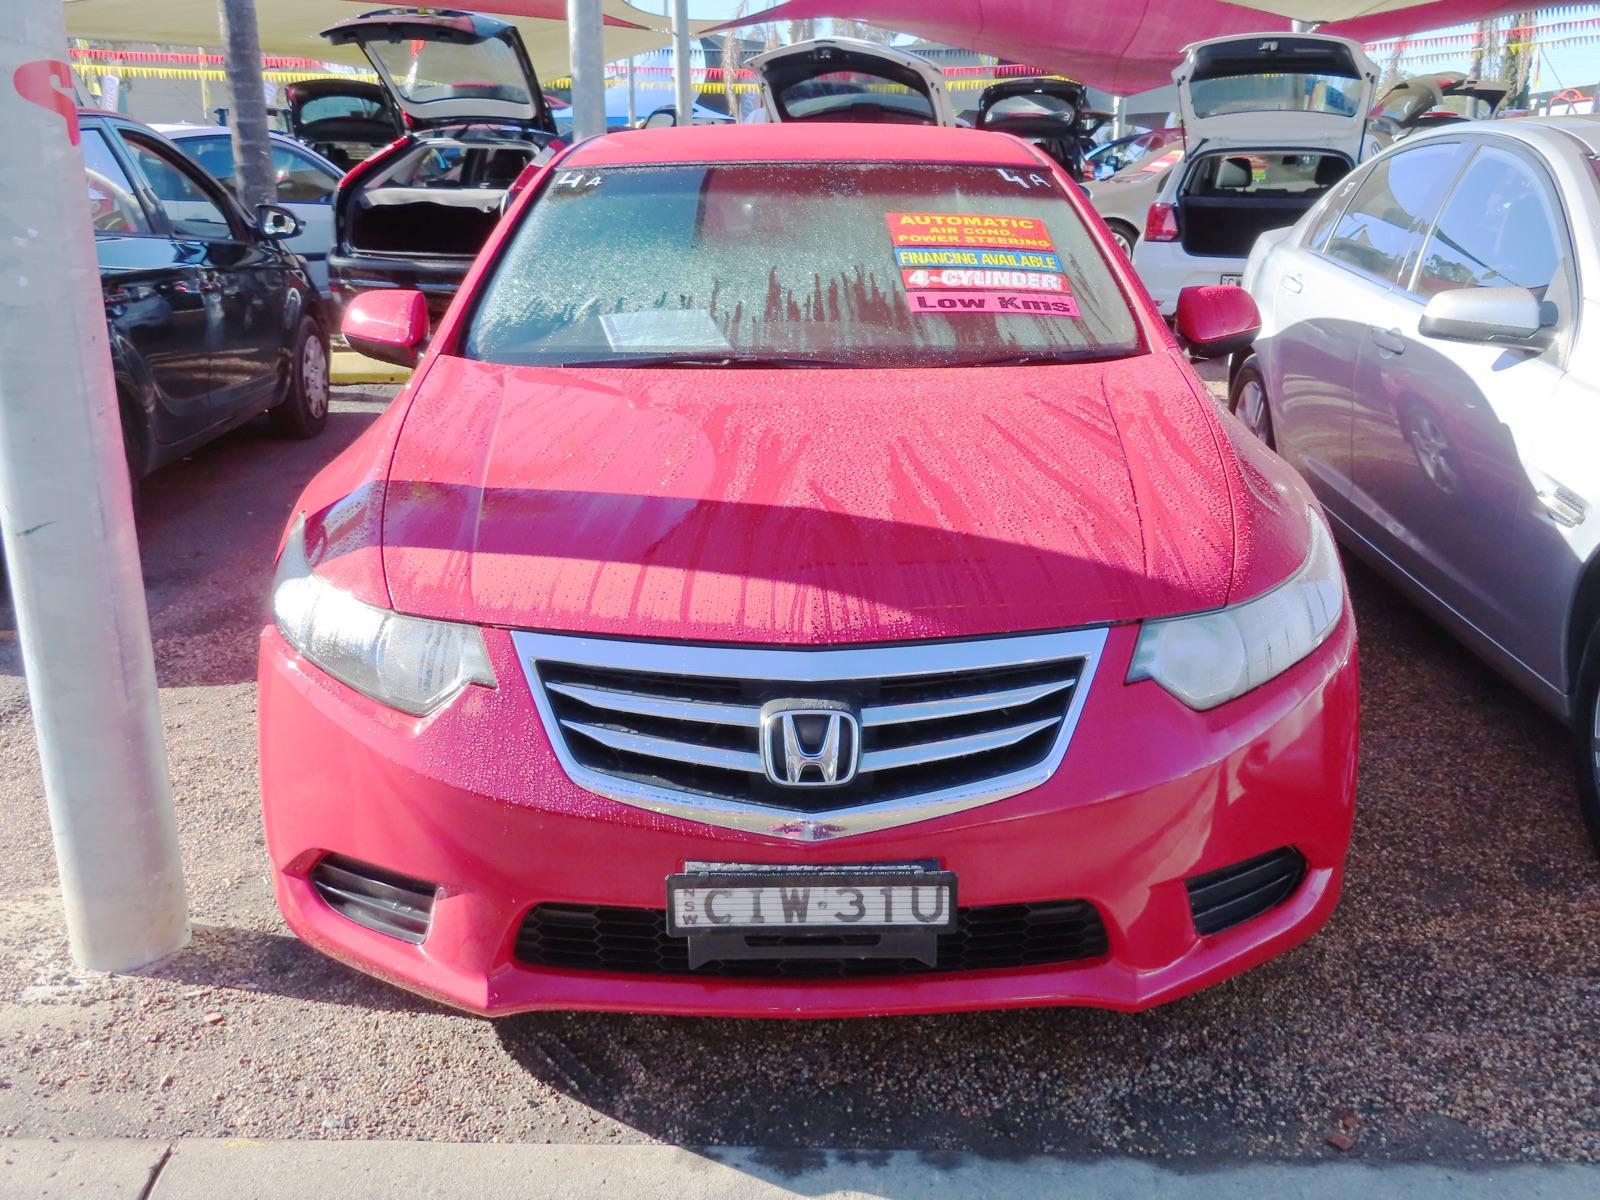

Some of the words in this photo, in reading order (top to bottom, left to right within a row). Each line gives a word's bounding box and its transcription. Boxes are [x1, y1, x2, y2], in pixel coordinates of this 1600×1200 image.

[900, 215, 1035, 229] AUTOMATIC
[929, 226, 958, 234] AIR
[898, 235, 960, 243] POWER
[964, 235, 1051, 247] STEERING
[900, 251, 978, 266] FINANCING
[981, 252, 1058, 269] AVAILABLE
[908, 269, 1062, 291] 4-CYLINDER
[997, 296, 1071, 312] Kms
